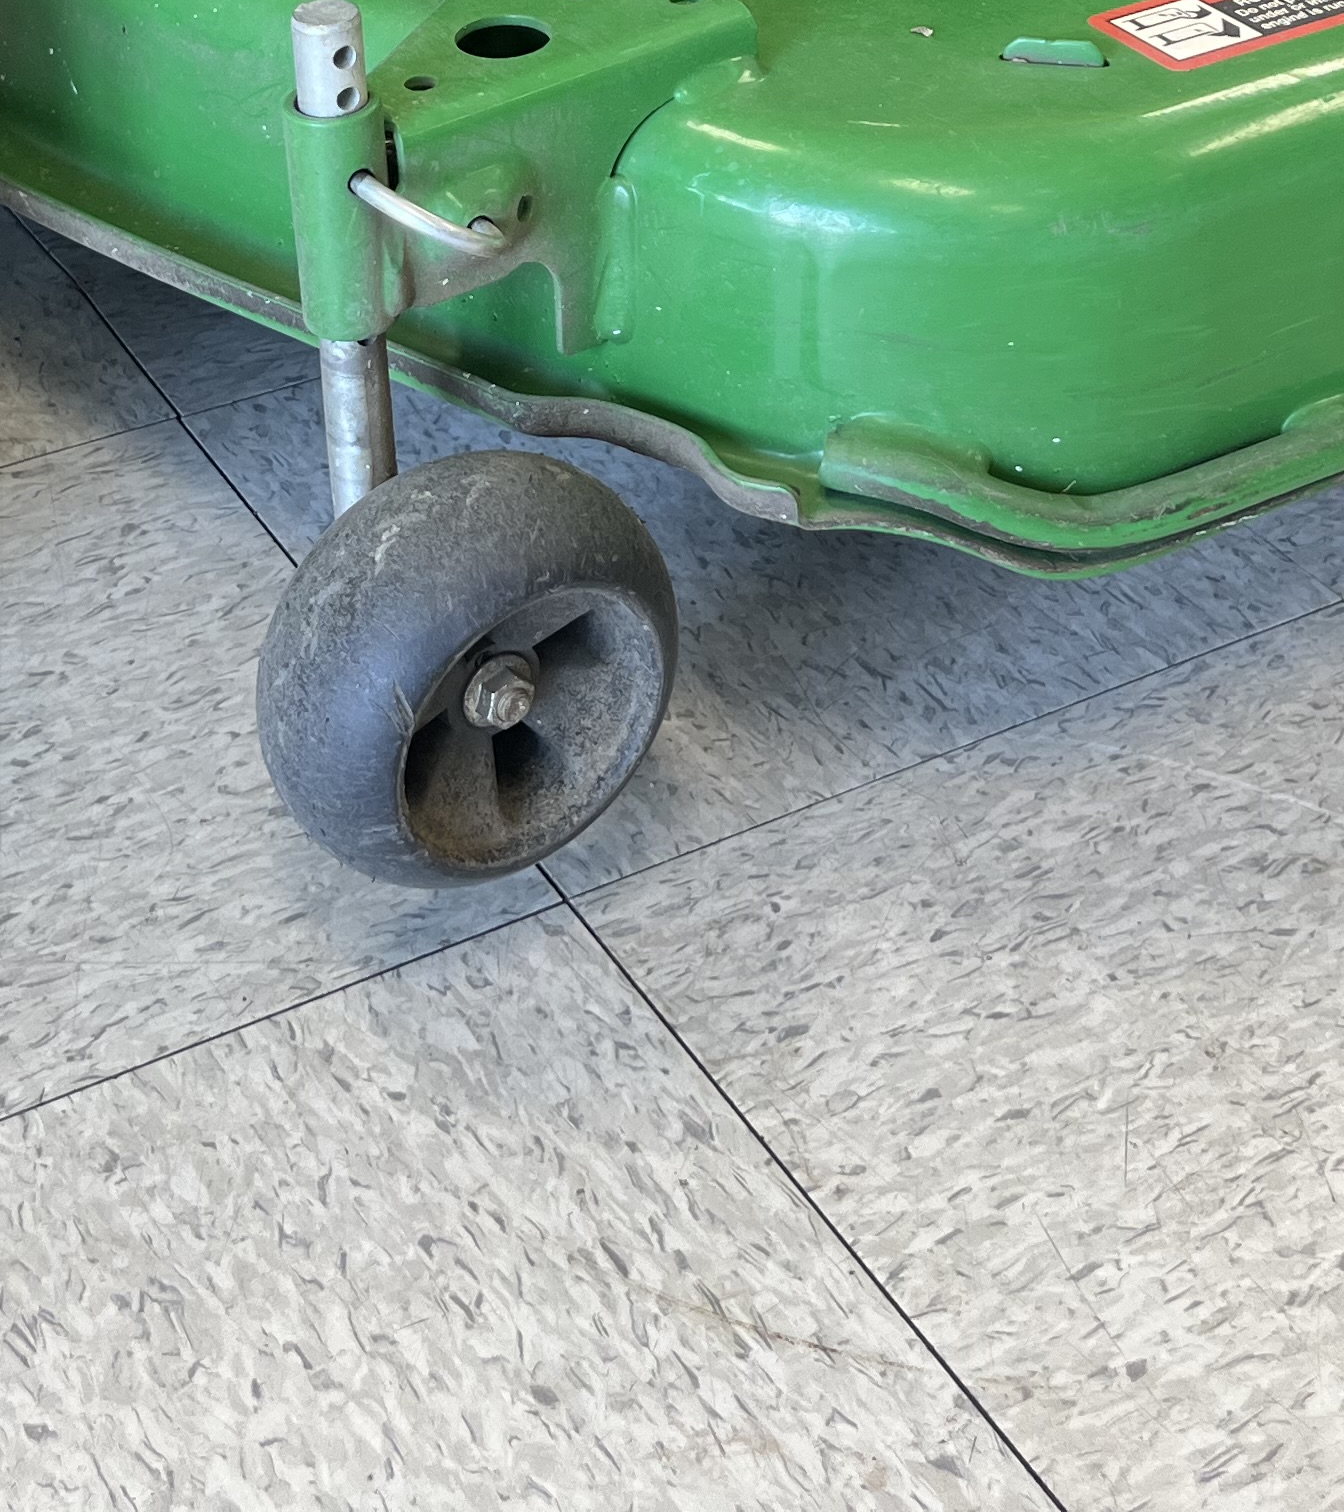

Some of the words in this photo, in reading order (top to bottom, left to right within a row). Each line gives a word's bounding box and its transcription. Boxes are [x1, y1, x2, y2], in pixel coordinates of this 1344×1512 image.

[1234, 7, 1259, 17] Do
[1258, 0, 1285, 11] not
[1249, 7, 1289, 23] under
[1289, 2, 1306, 11] or
[1261, 11, 1309, 30] engine
[1305, 7, 1324, 16] is
